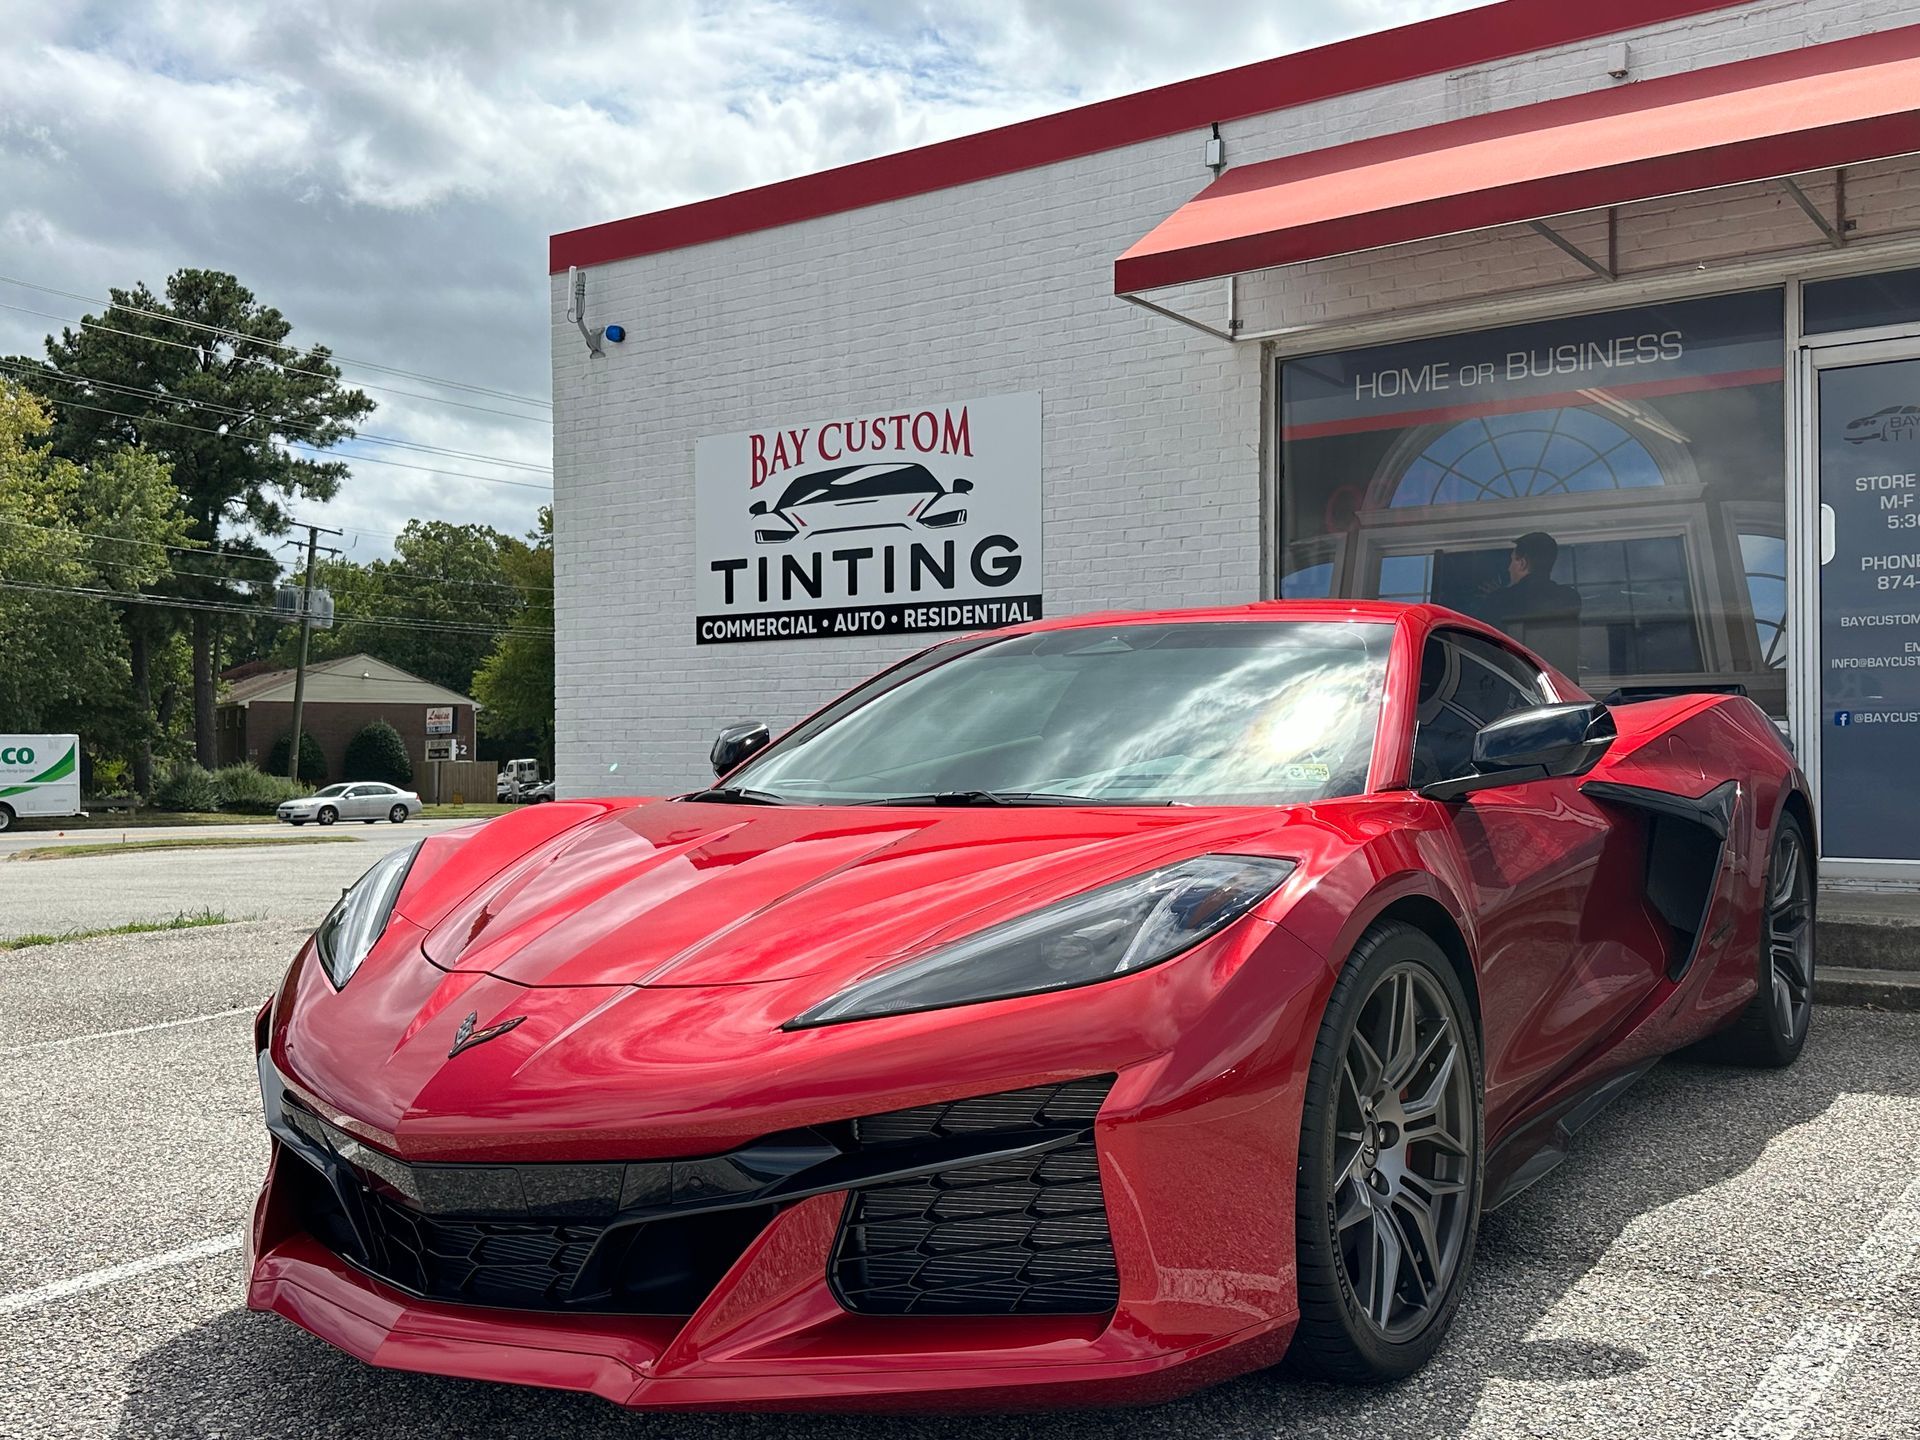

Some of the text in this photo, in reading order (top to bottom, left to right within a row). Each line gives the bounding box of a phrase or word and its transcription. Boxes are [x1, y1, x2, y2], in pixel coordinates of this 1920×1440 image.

[1355, 331, 1683, 400] HOME OR BUSINESS
[749, 405, 974, 490] BAY CUSTOM
[1855, 473, 1916, 492] STORE
[1880, 493, 1914, 510] M-F
[1887, 514, 1920, 529] 5:3
[711, 534, 1022, 605] TINTING
[702, 601, 1034, 639] COMMERCIAL AUTO RESIDENTIAL
